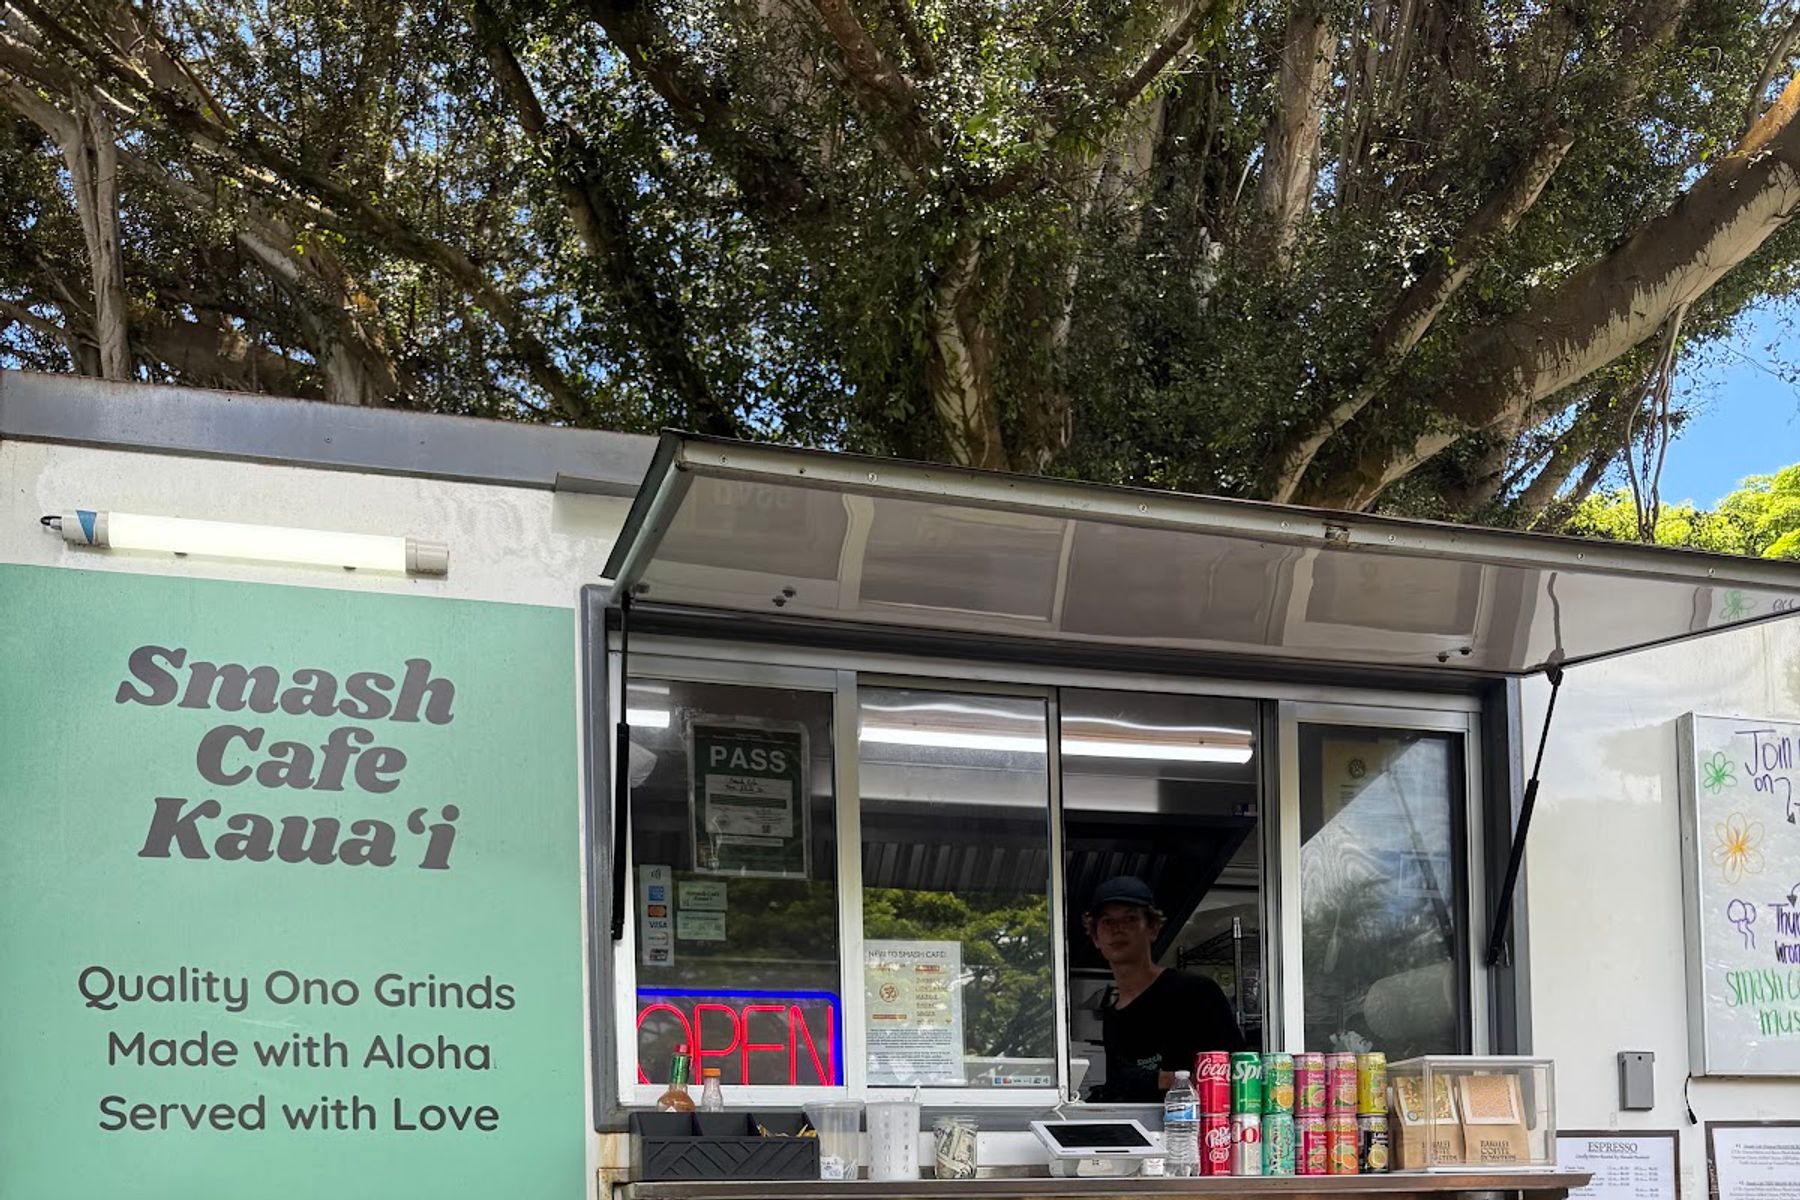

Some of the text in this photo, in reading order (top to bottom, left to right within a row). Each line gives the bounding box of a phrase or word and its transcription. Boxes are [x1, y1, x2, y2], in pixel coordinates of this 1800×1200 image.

[115, 644, 457, 726] Smash
[196, 724, 408, 794] Cafe
[710, 746, 786, 773] PASS
[77, 965, 515, 1013] Quality Ono Grinds
[108, 1031, 491, 1070] Made with Aloha
[637, 1002, 836, 1086] OPEN
[99, 1095, 499, 1132] Served with Love
[1588, 1142, 1638, 1153] ESPRESSO
